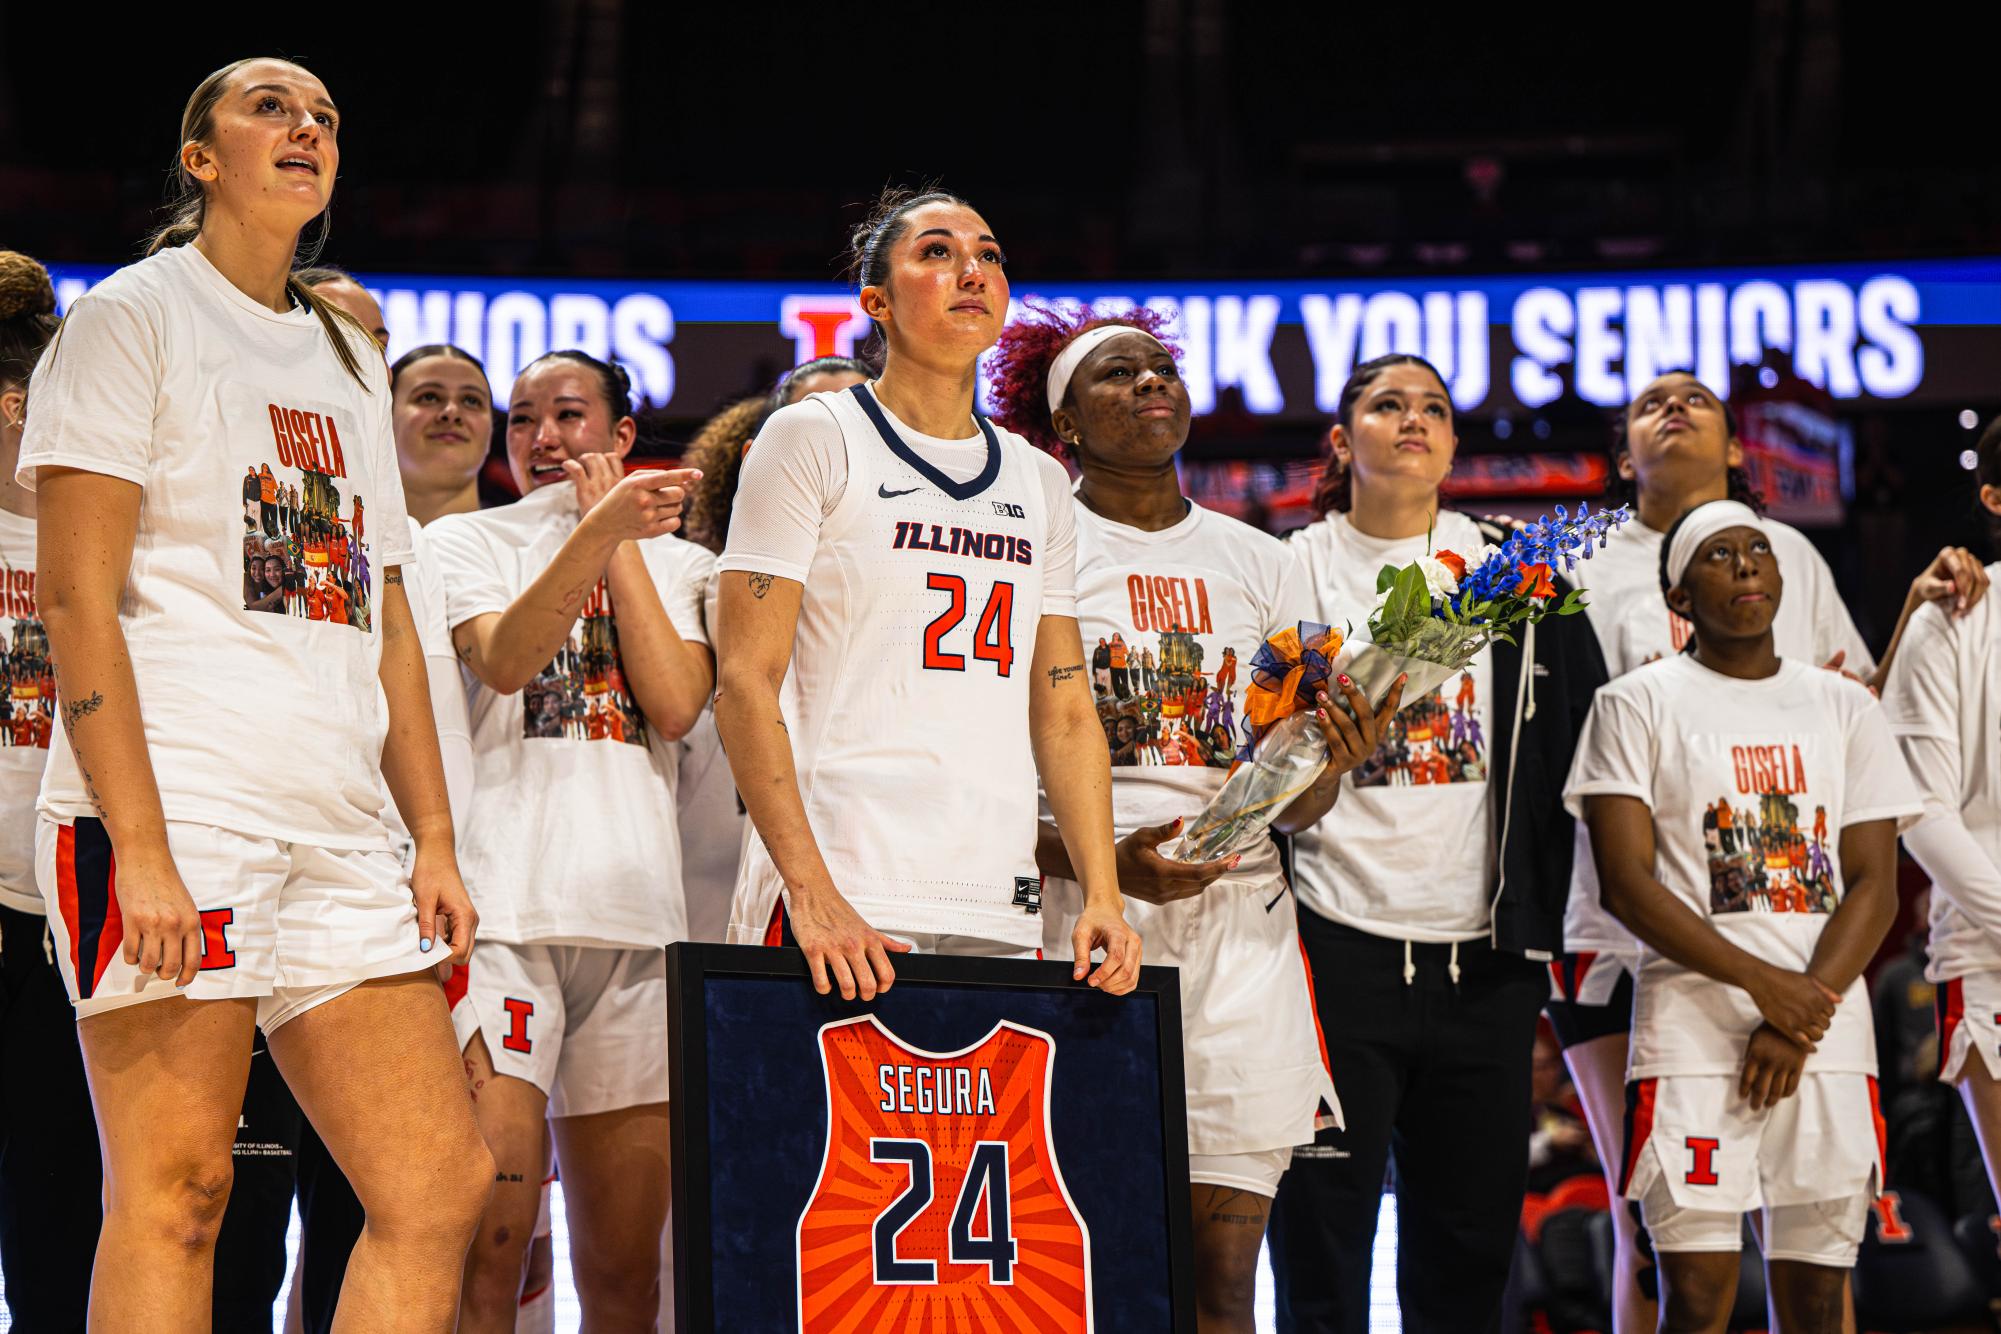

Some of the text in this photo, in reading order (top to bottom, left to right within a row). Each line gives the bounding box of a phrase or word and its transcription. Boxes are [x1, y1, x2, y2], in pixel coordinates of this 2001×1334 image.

[1301, 289, 1490, 412] YOU
[1511, 275, 1926, 409] SENIORS
[268, 403, 347, 478] GISELA
[892, 521, 1032, 565] ILLINOIS
[923, 572, 1014, 678] 24
[1127, 574, 1213, 634] GISELA
[1732, 744, 1807, 795] GISELA
[879, 1064, 996, 1116] SEGURA
[869, 1137, 1018, 1285] 24
